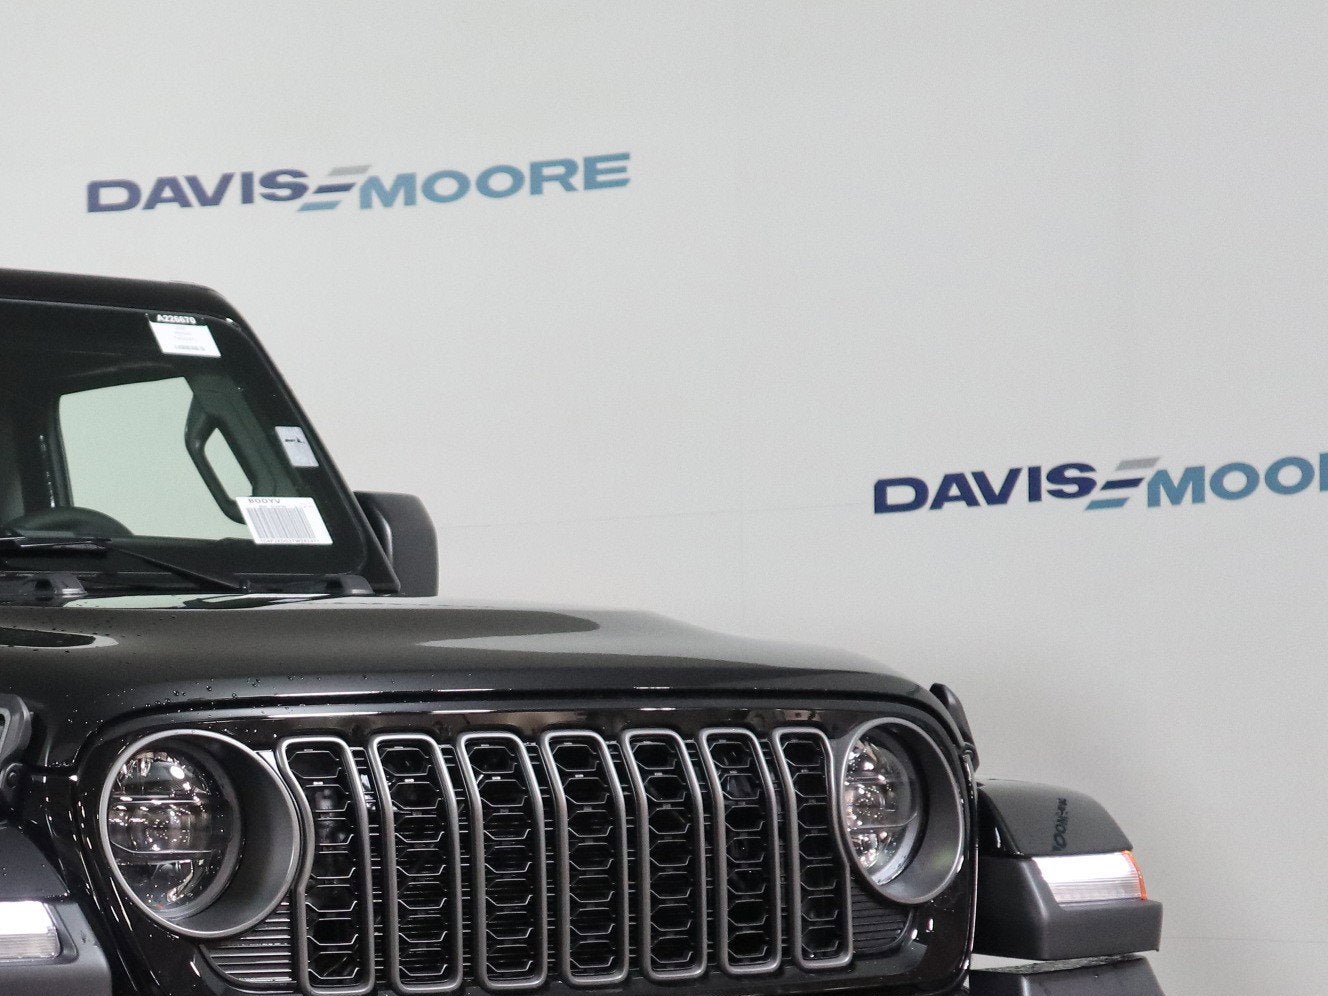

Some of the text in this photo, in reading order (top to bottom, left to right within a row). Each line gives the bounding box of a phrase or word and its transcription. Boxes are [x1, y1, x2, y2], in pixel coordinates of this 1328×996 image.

[86, 151, 632, 214] DAVIS MOORE
[874, 452, 1328, 514] DAVIS MOO
